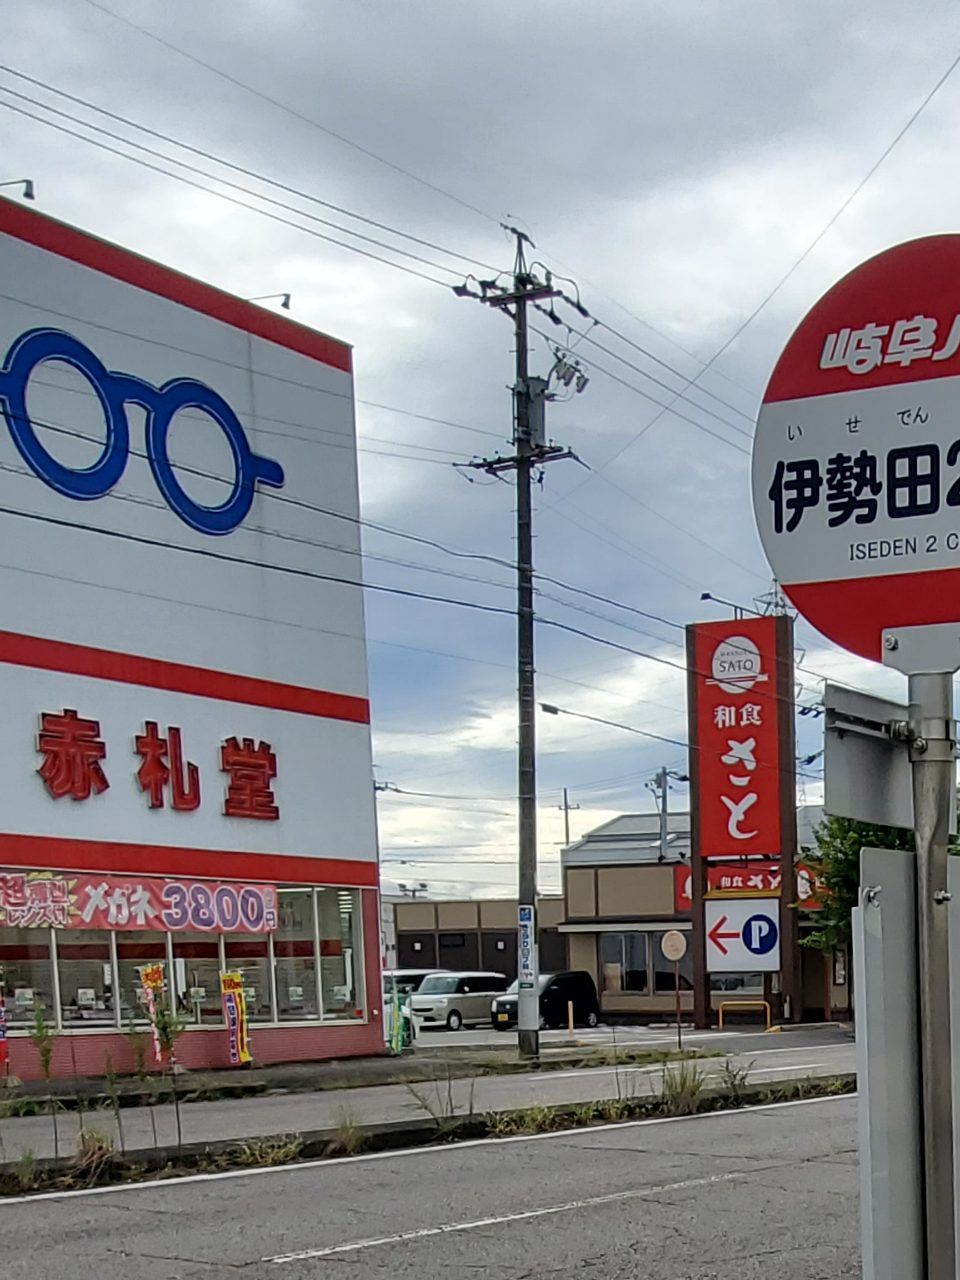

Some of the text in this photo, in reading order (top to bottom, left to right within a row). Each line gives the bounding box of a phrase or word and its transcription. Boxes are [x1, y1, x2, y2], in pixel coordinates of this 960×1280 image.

[787, 425, 803, 441] い
[845, 417, 862, 433] せ
[897, 407, 929, 425] でん
[849, 538, 917, 561] ISEDEN
[926, 535, 938, 553] 2
[719, 659, 754, 673] SATO
[714, 703, 762, 728] 和食
[36, 708, 279, 820] 赤札堂
[720, 736, 758, 839] さと
[81, 882, 158, 926] メガネ
[751, 920, 769, 949] P
